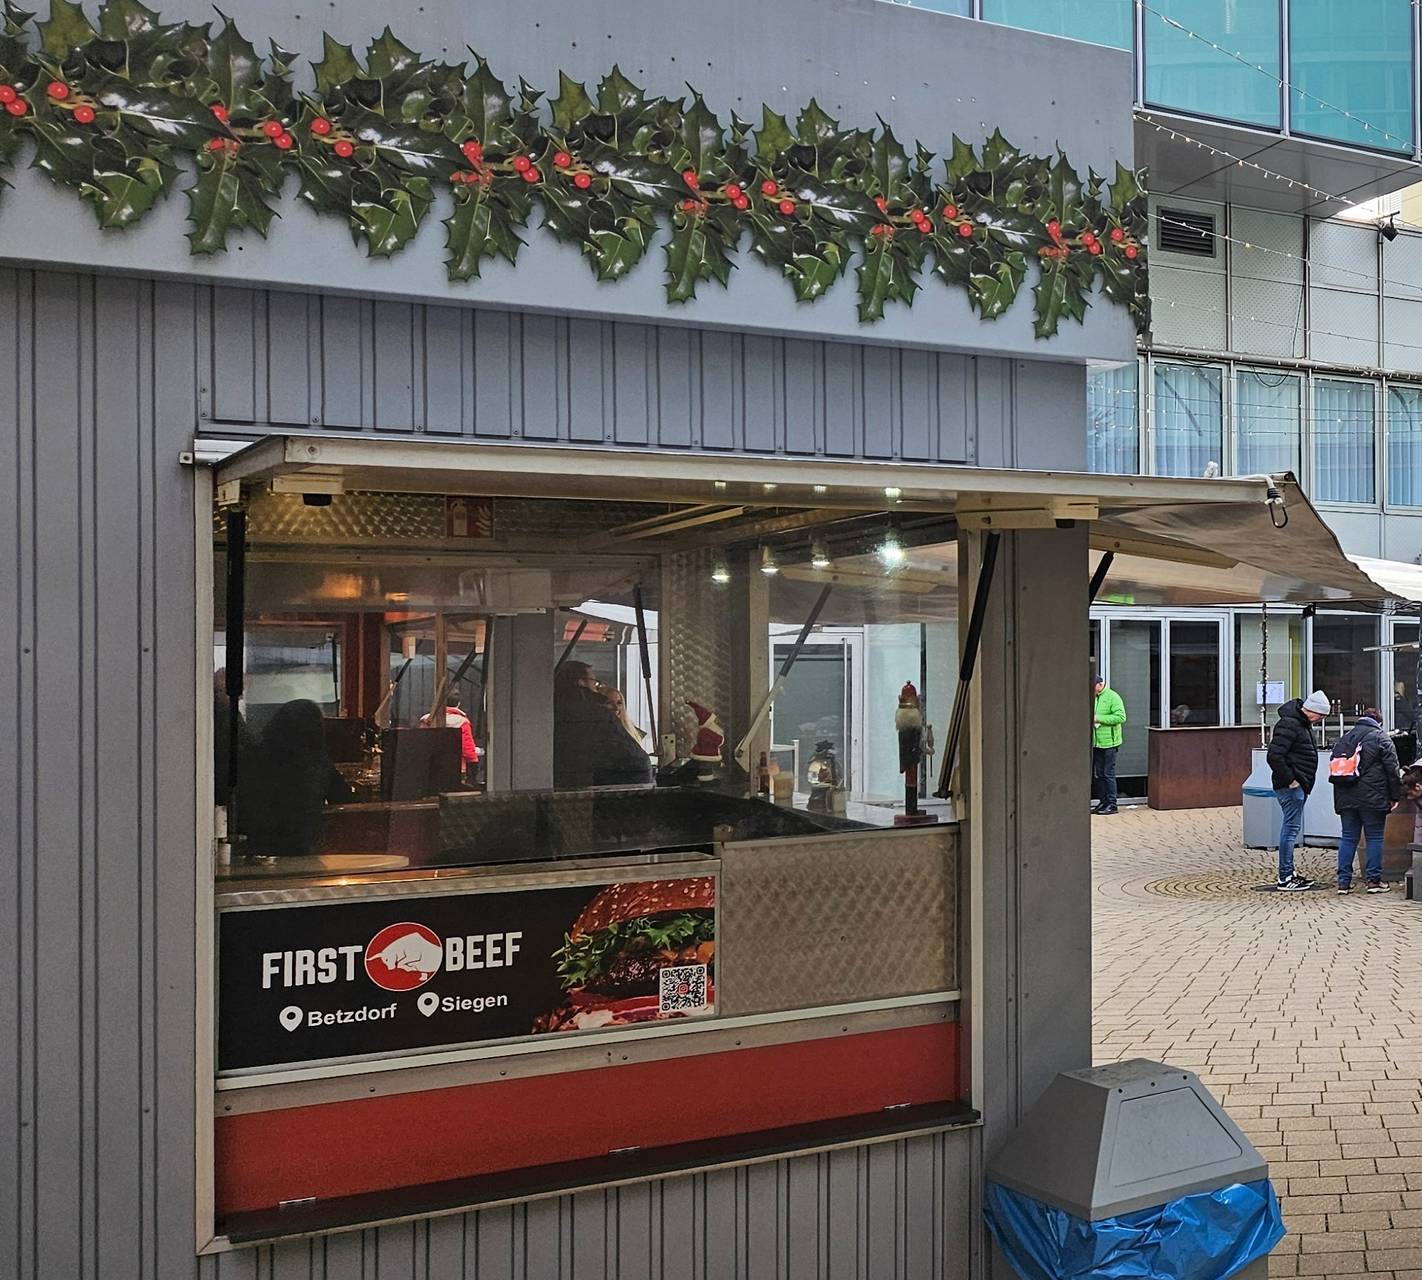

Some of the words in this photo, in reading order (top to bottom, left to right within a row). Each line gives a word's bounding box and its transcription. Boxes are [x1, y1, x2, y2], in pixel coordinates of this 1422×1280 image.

[262, 943, 363, 989] FIRST
[445, 931, 523, 972] BEEF
[307, 1002, 398, 1028] Betzdorf
[441, 991, 508, 1013] Siegen
